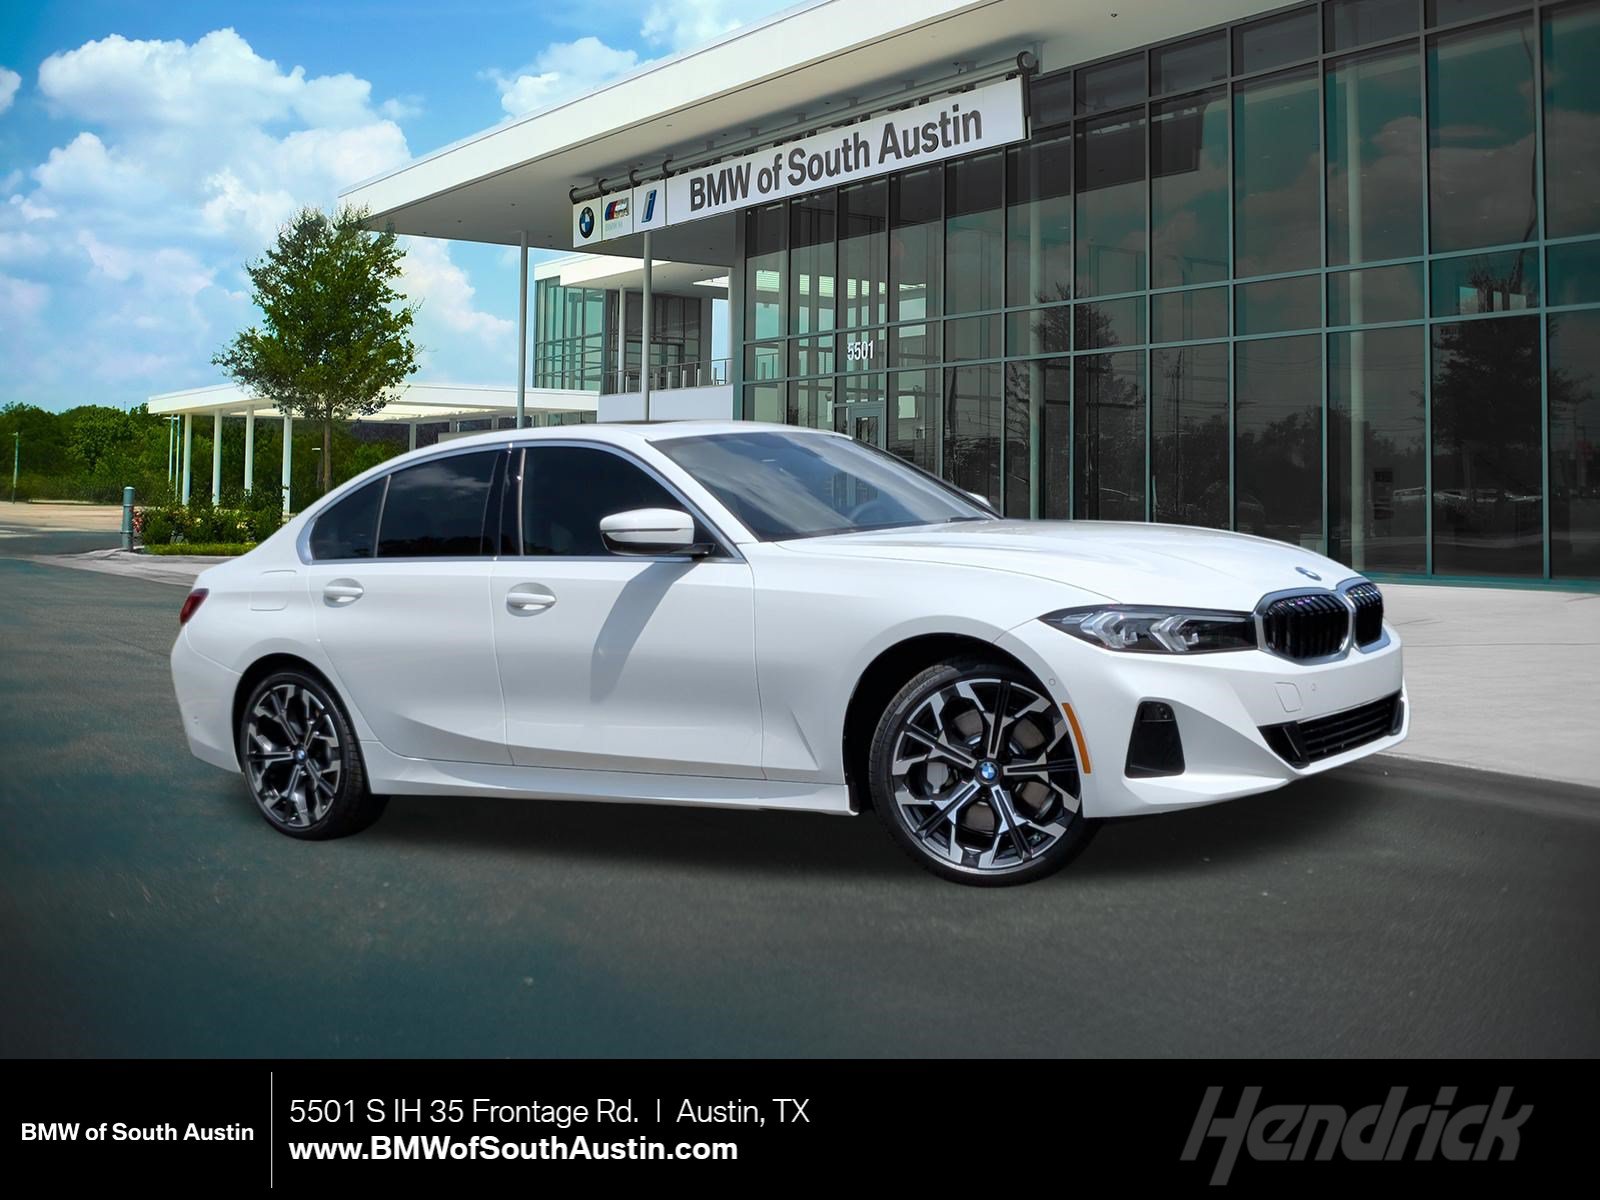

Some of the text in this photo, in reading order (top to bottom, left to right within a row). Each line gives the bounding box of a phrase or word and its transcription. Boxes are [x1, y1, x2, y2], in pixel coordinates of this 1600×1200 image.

[690, 163, 751, 211] BMW
[757, 153, 782, 193] of
[787, 132, 870, 186] South
[878, 104, 982, 164] Austin
[847, 340, 873, 360] 5501
